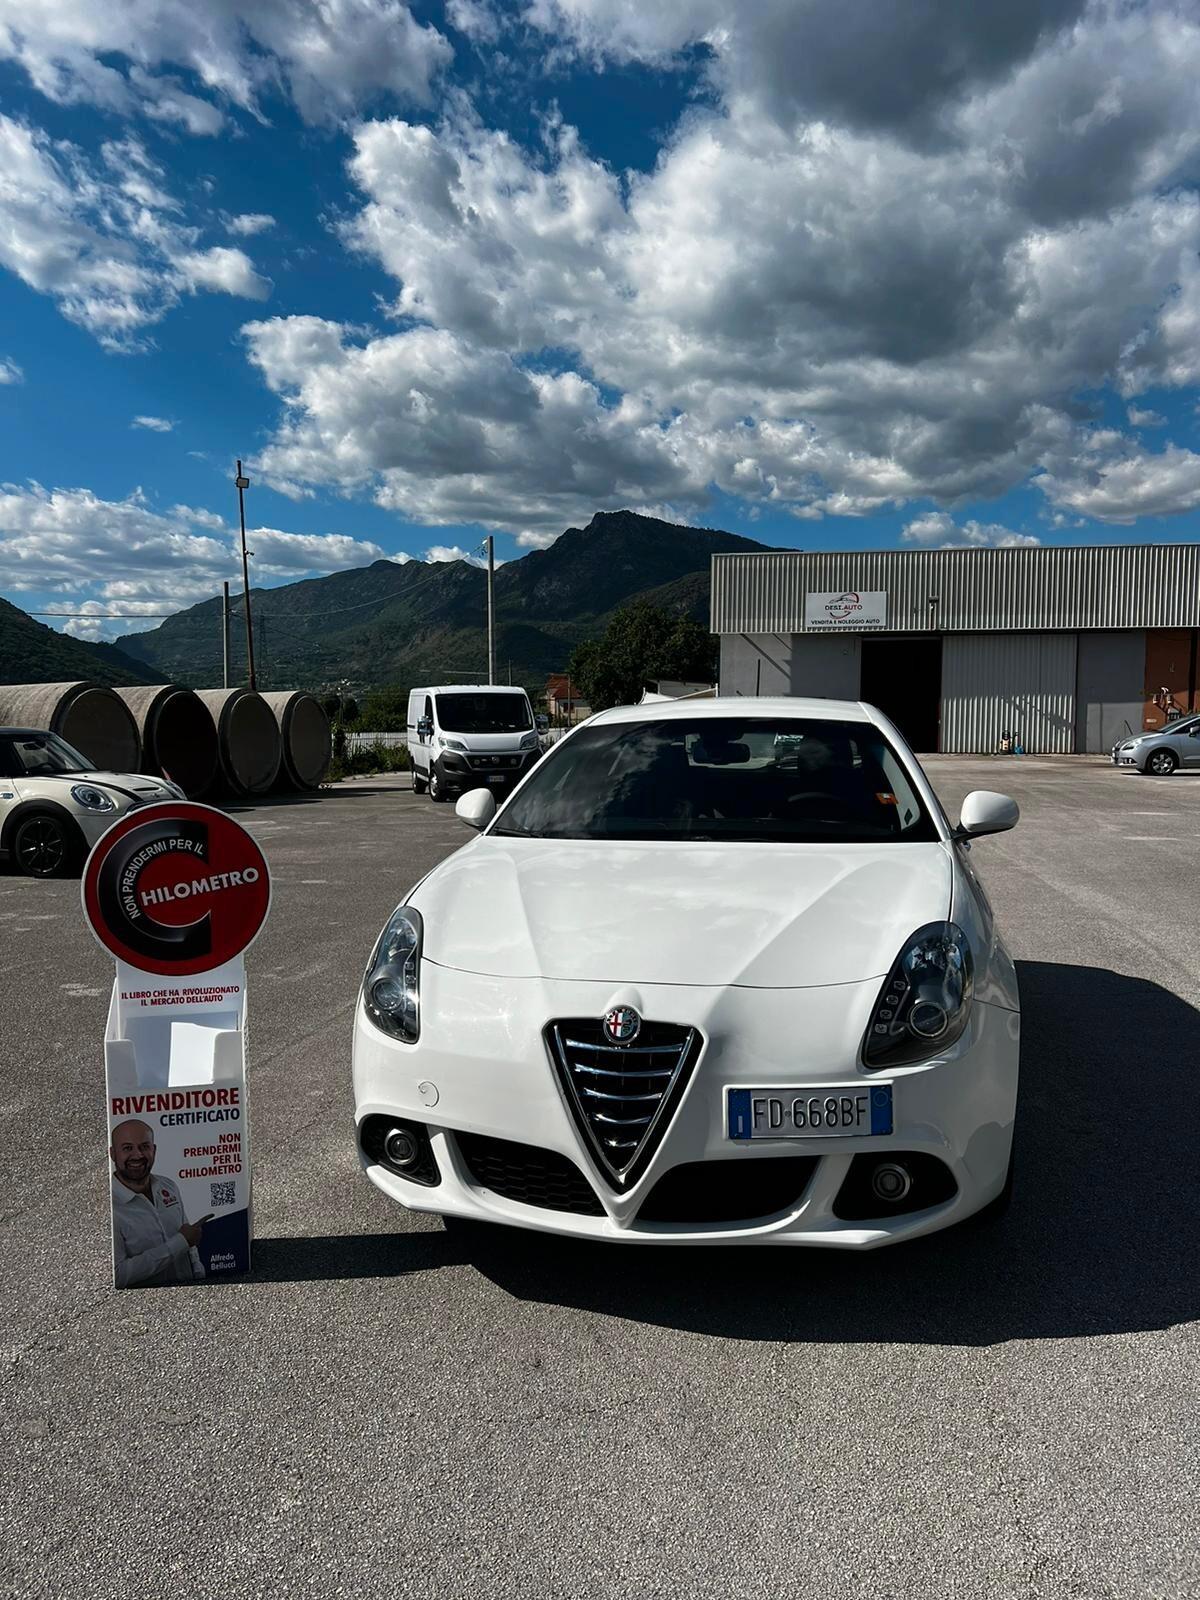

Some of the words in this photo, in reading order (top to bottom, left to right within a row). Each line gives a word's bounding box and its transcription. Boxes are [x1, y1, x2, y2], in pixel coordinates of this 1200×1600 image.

[169, 838, 192, 850] PER
[194, 842, 205, 857] IL
[121, 841, 167, 892] PRENDERMI
[121, 891, 141, 919] NON
[121, 991, 128, 1000] IL
[129, 990, 152, 999] LIBRO
[153, 989, 167, 998] CHE
[168, 988, 180, 997] HA
[182, 985, 240, 996] RIVOLUZIONATO
[140, 998, 148, 1007] IL
[150, 996, 186, 1006] MERCATO
[186, 994, 223, 1004] DELL'AUTO
[112, 1088, 240, 1116] RIVENDITORE
[160, 1108, 240, 1127] CERTIFICATO
[218, 1132, 241, 1143] NON
[183, 1144, 241, 1158] PRENDERMI
[213, 1155, 232, 1165] PER
[233, 1153, 242, 1163] IL
[178, 1163, 242, 1179] CHILOMETRO
[210, 1253, 235, 1262] Alfredo
[210, 1261, 236, 1270] Bellucci
